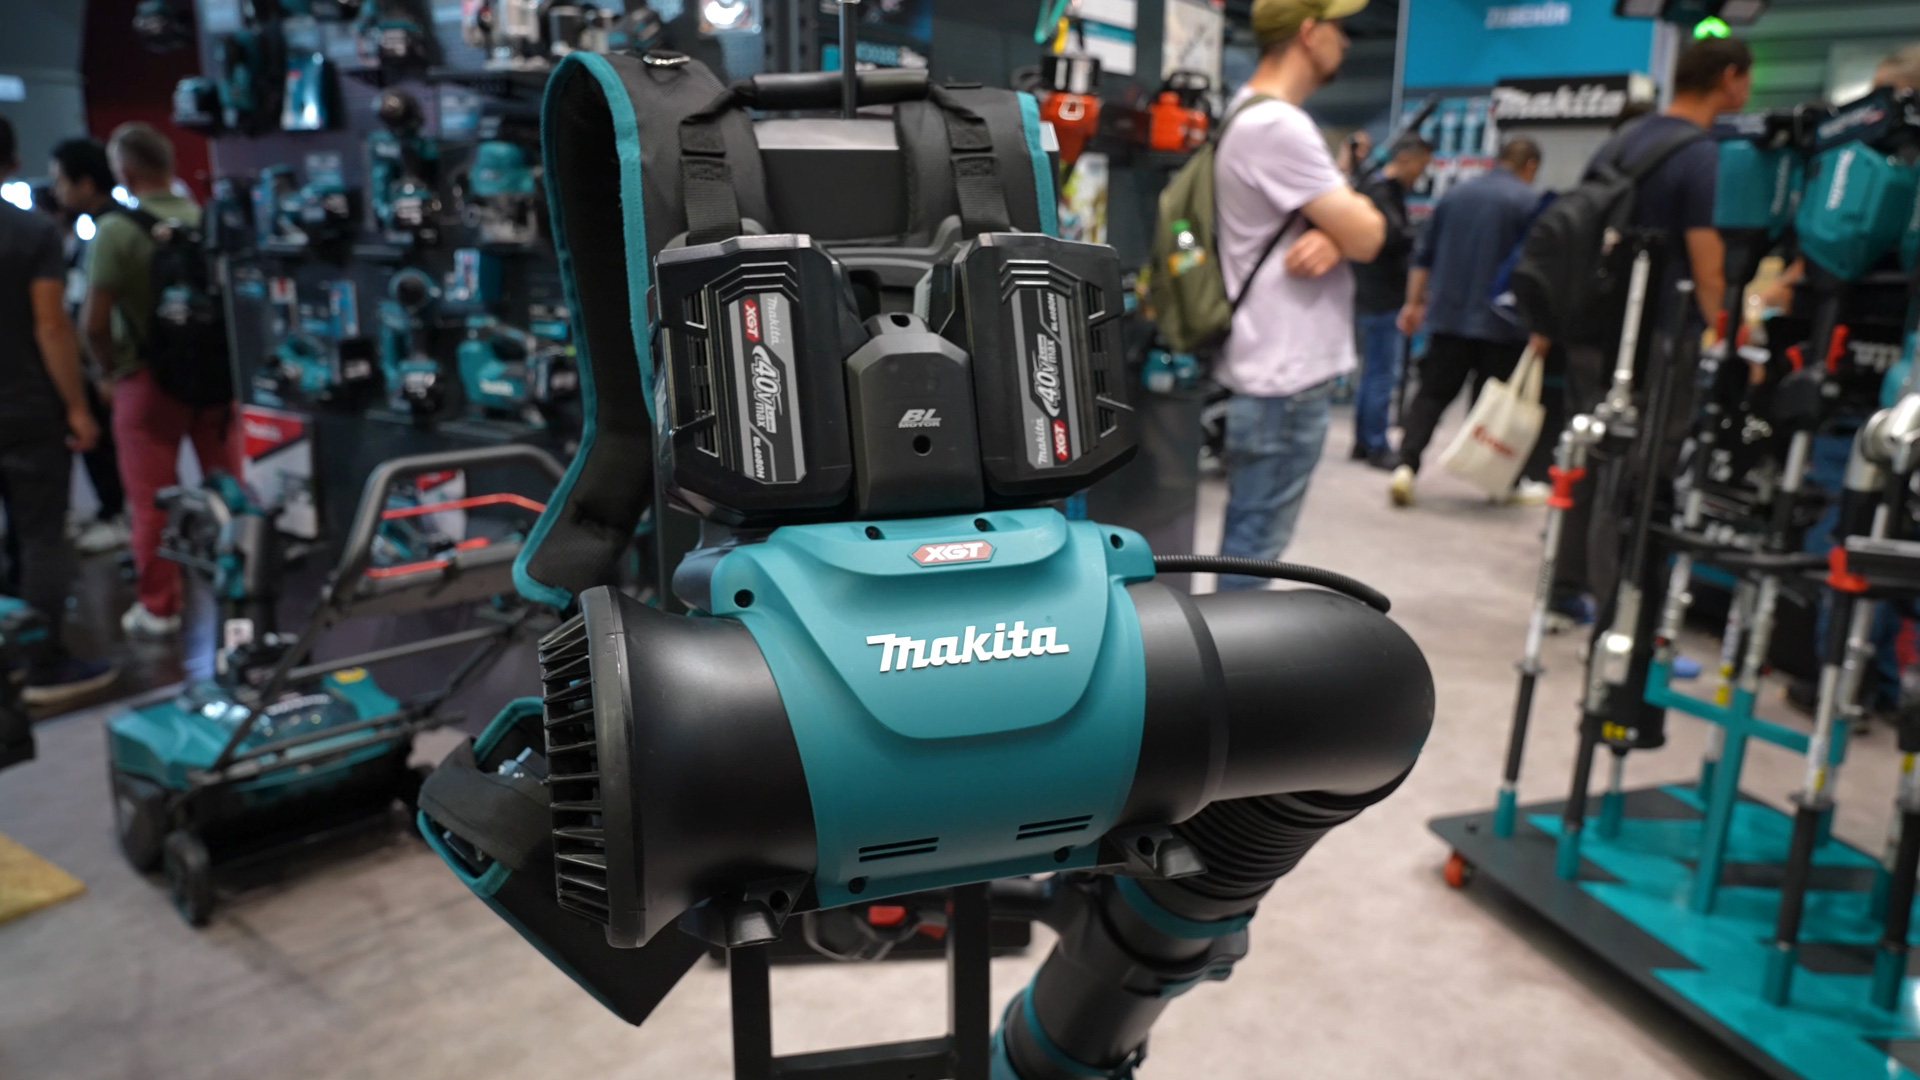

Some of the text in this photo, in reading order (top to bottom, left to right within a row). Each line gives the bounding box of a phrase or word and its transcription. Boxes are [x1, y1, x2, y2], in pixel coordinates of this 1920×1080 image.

[745, 304, 759, 338] XGT
[899, 408, 942, 421] BL
[898, 420, 940, 428] MOTOR
[1054, 424, 1068, 456] XGT
[924, 543, 983, 561] XGT
